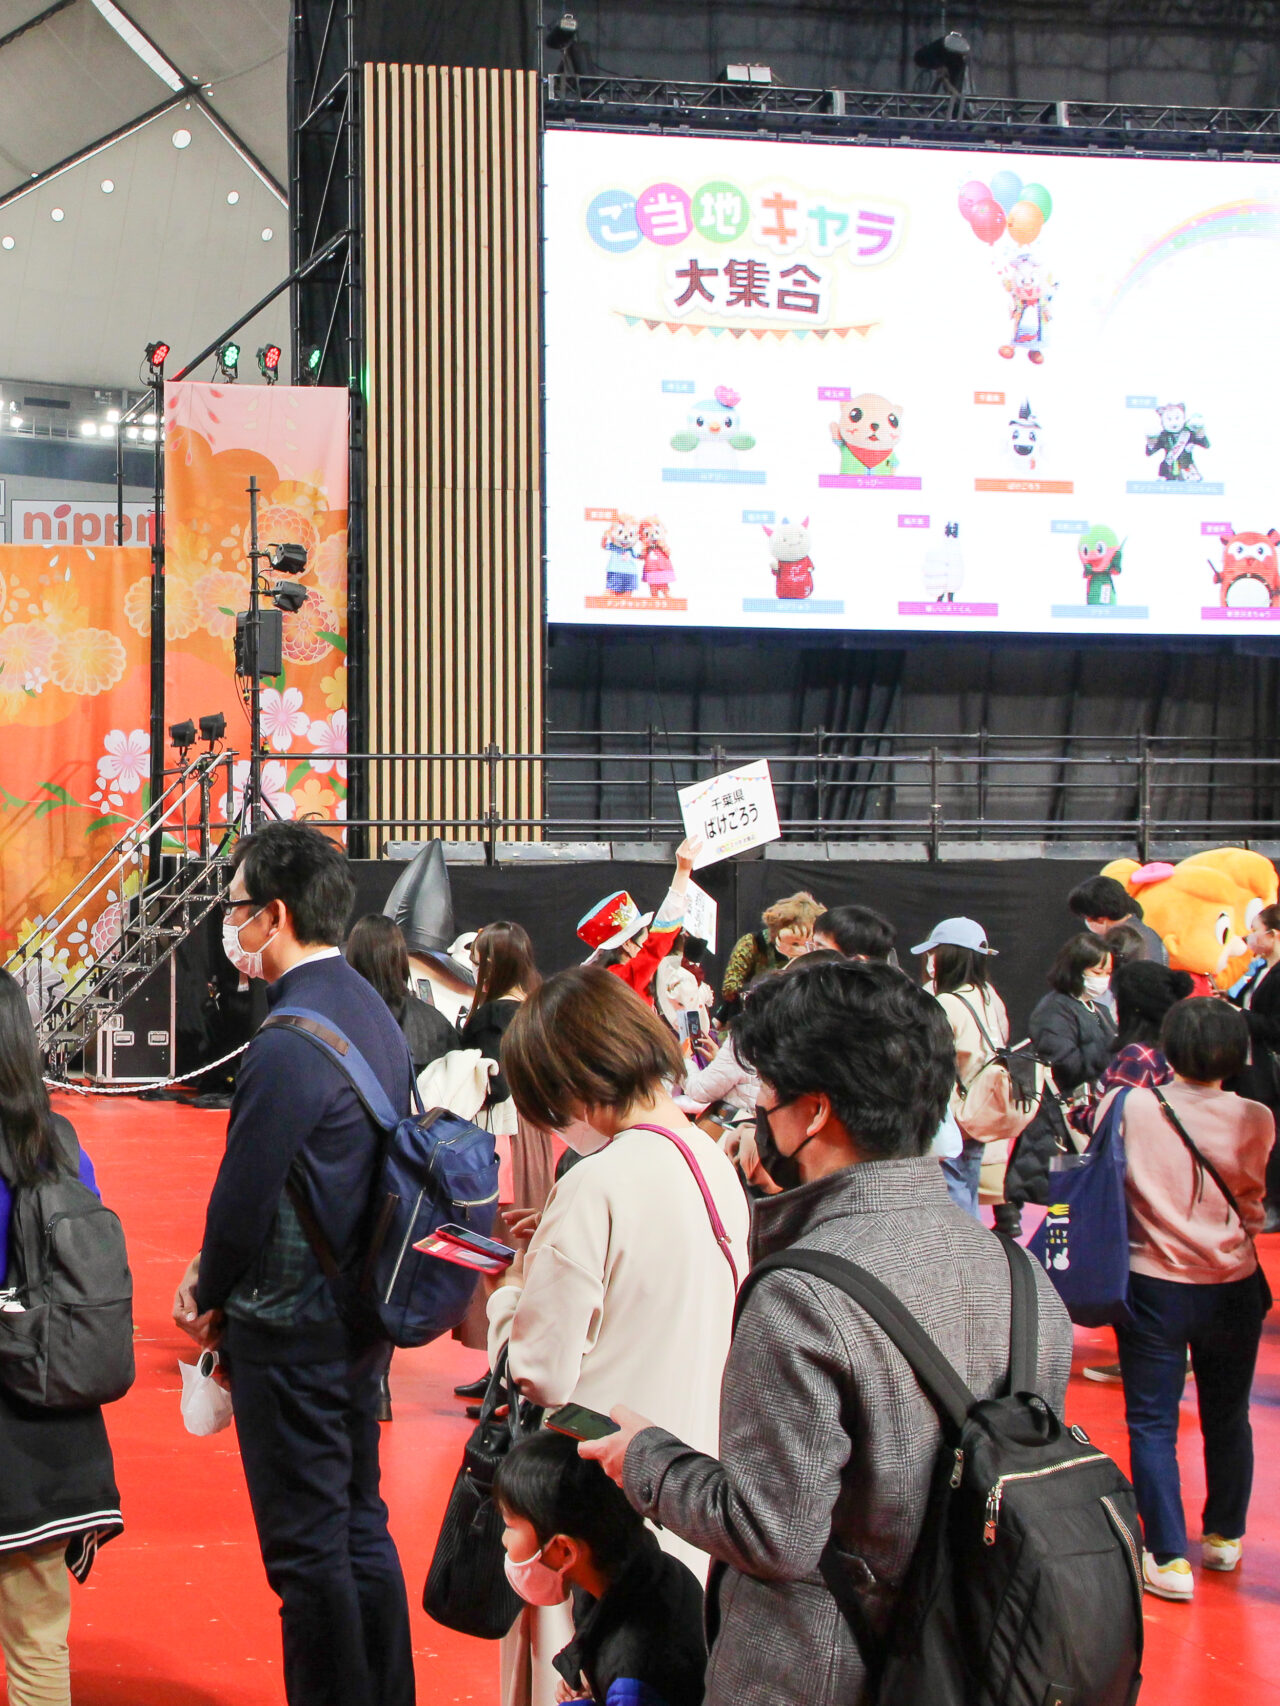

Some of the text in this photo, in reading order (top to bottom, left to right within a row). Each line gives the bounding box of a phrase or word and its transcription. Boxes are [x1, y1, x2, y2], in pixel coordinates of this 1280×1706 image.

[598, 190, 896, 256] ご当地キャラ
[673, 258, 822, 315] 大集合
[704, 803, 759, 840] ばけごろう
[711, 788, 745, 811] 千葉県
